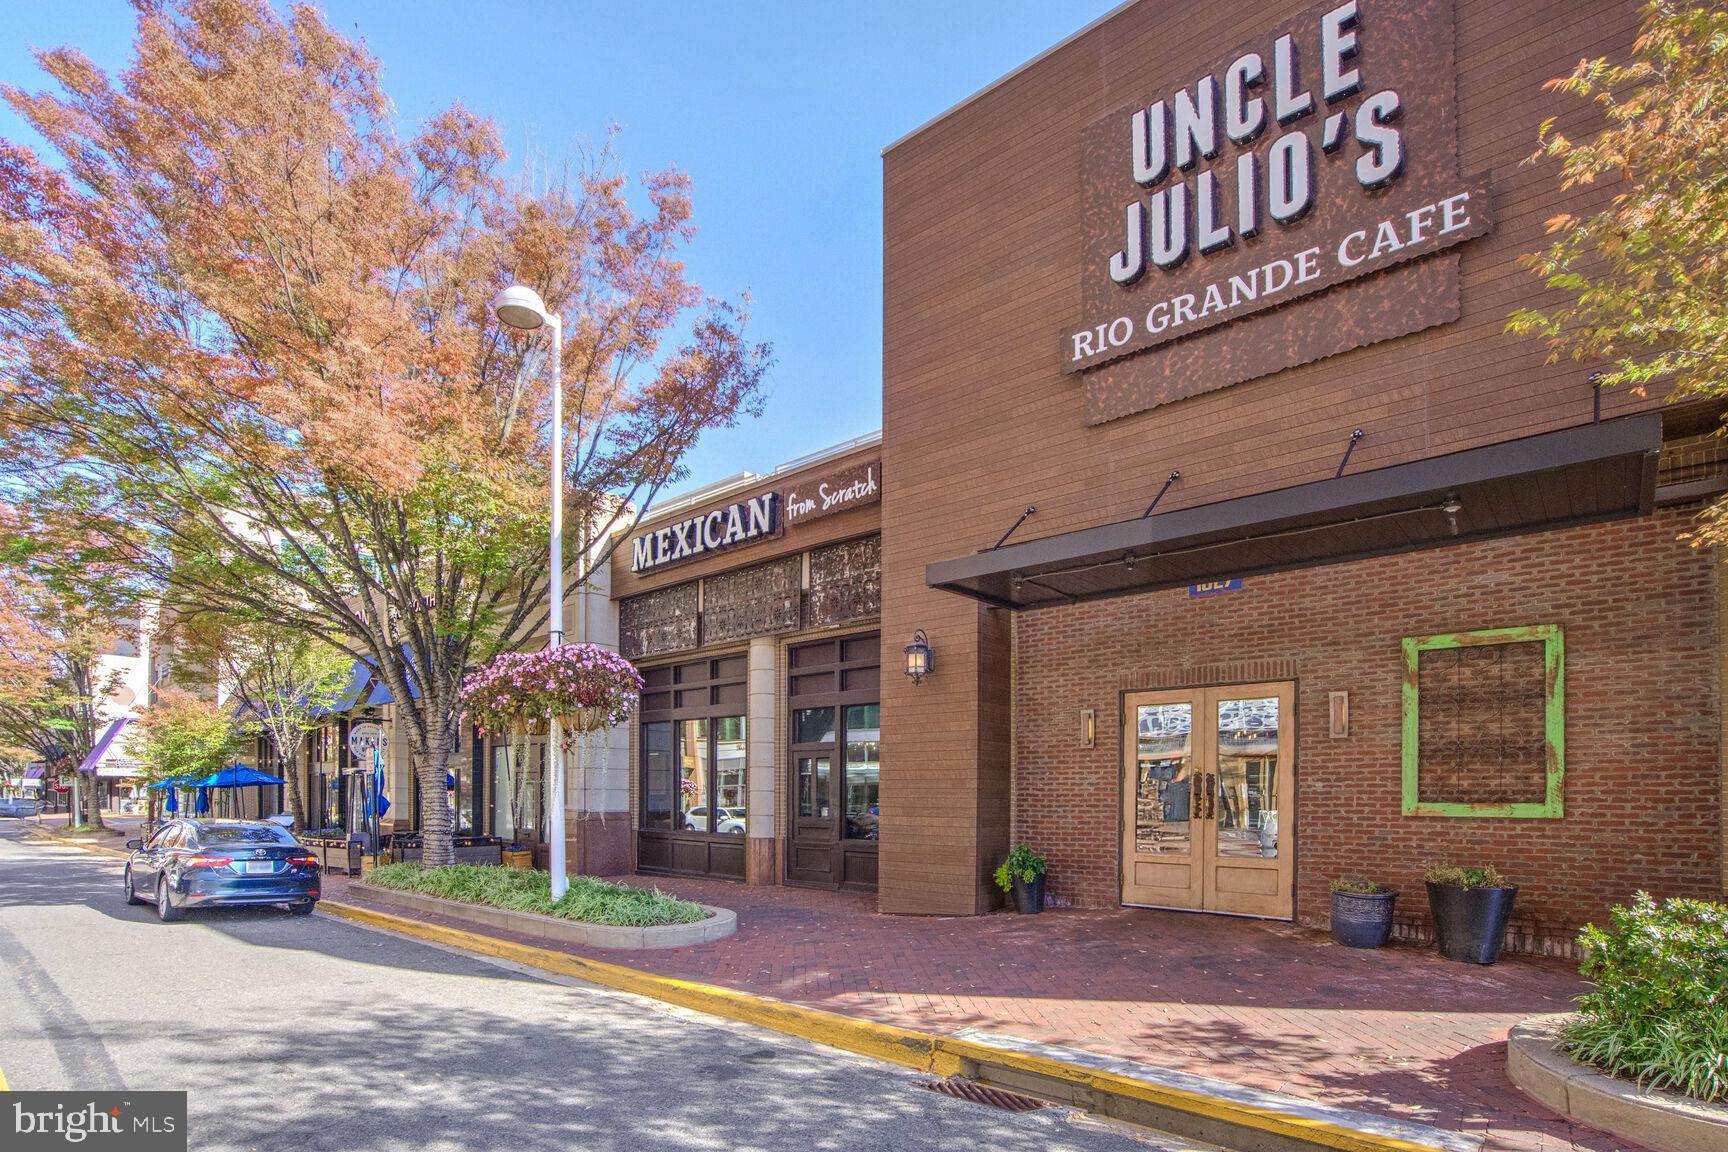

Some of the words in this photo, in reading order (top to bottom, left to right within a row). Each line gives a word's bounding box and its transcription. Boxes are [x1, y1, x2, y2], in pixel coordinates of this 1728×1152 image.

[1131, 0, 1361, 186] UNCLE
[1109, 88, 1402, 285] JULIO'S
[1071, 316, 1134, 361] RIO
[1145, 246, 1322, 334] GRANDE
[1336, 192, 1472, 267] CAFE
[631, 492, 774, 573] MEXICAN
[786, 493, 816, 520] from
[819, 467, 877, 511] Scratch
[351, 736, 388, 747] MAKS
